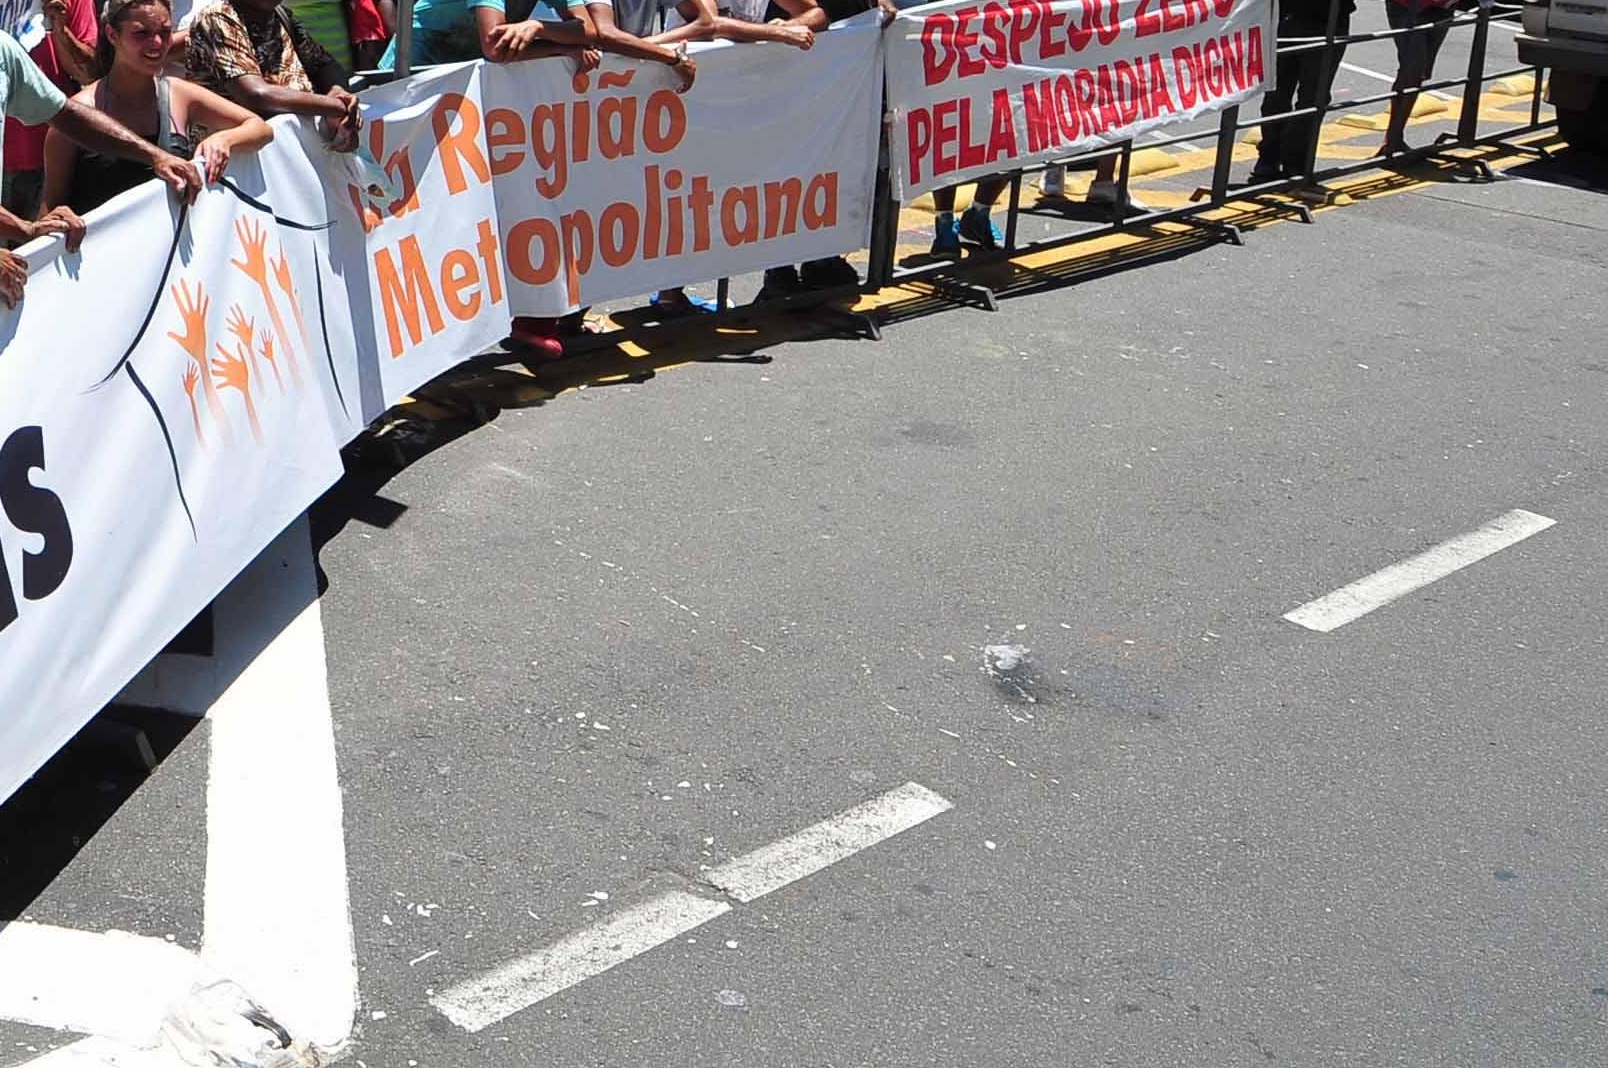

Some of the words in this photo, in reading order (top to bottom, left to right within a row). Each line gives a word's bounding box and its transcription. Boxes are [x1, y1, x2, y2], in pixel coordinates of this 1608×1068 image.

[431, 68, 687, 200] Região
[907, 88, 1018, 187] PELA
[1022, 52, 1175, 154] MORADIA
[1171, 26, 1265, 110] DIGNA
[373, 164, 839, 359] Metopolitana
